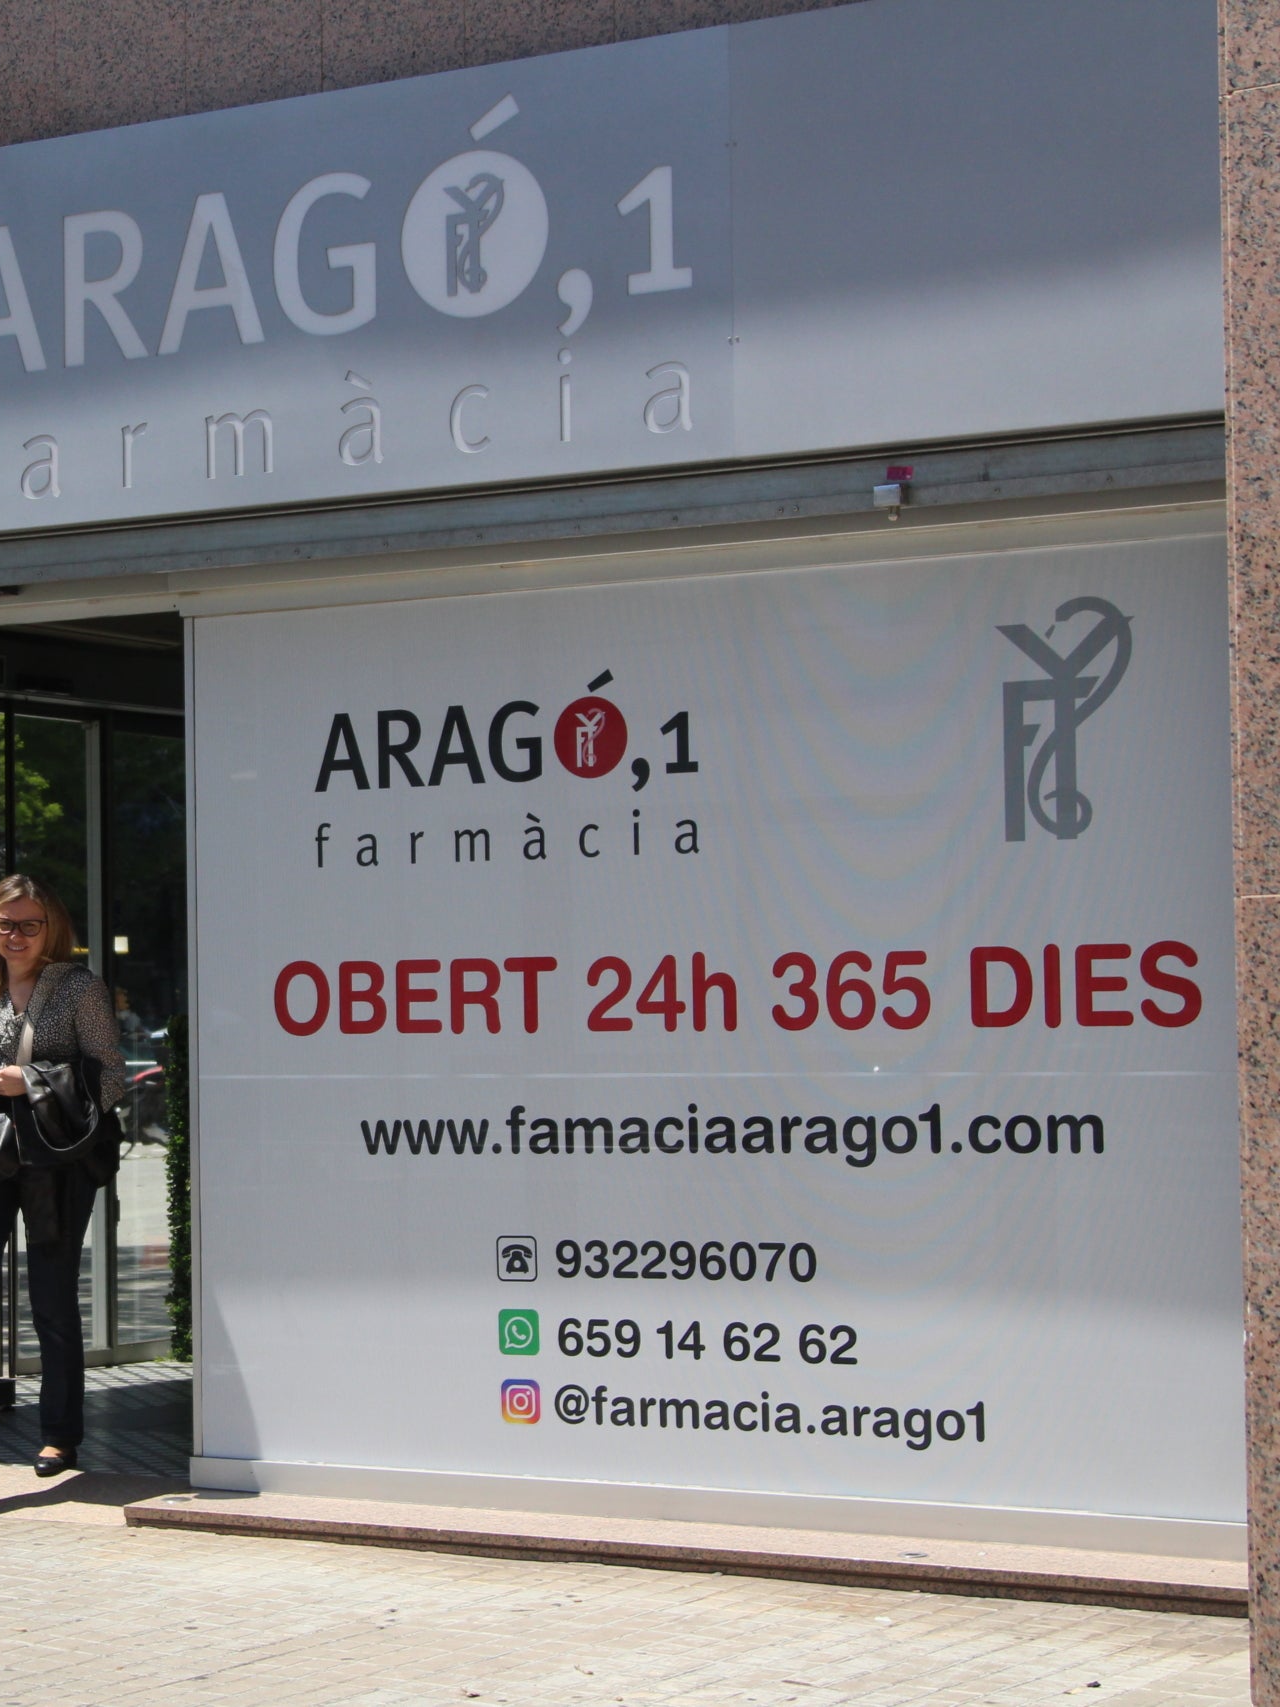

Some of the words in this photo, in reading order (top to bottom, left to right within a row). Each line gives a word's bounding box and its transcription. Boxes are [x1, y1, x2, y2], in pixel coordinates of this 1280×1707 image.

[315, 669, 699, 793] ARAGÓ,1
[315, 808, 700, 868] farmàcia
[275, 957, 557, 1036] OBERT
[588, 952, 737, 1031] 24h
[773, 951, 930, 1031] 365
[970, 941, 1201, 1027] DIES
[360, 1102, 1105, 1168] www.famaciaarago1.com
[555, 1239, 817, 1283] 932296070
[557, 1317, 641, 1358] 659
[656, 1320, 706, 1361] 14
[723, 1321, 781, 1363] 62
[798, 1324, 859, 1365] 62
[554, 1384, 985, 1451] @farmacia.arago1
